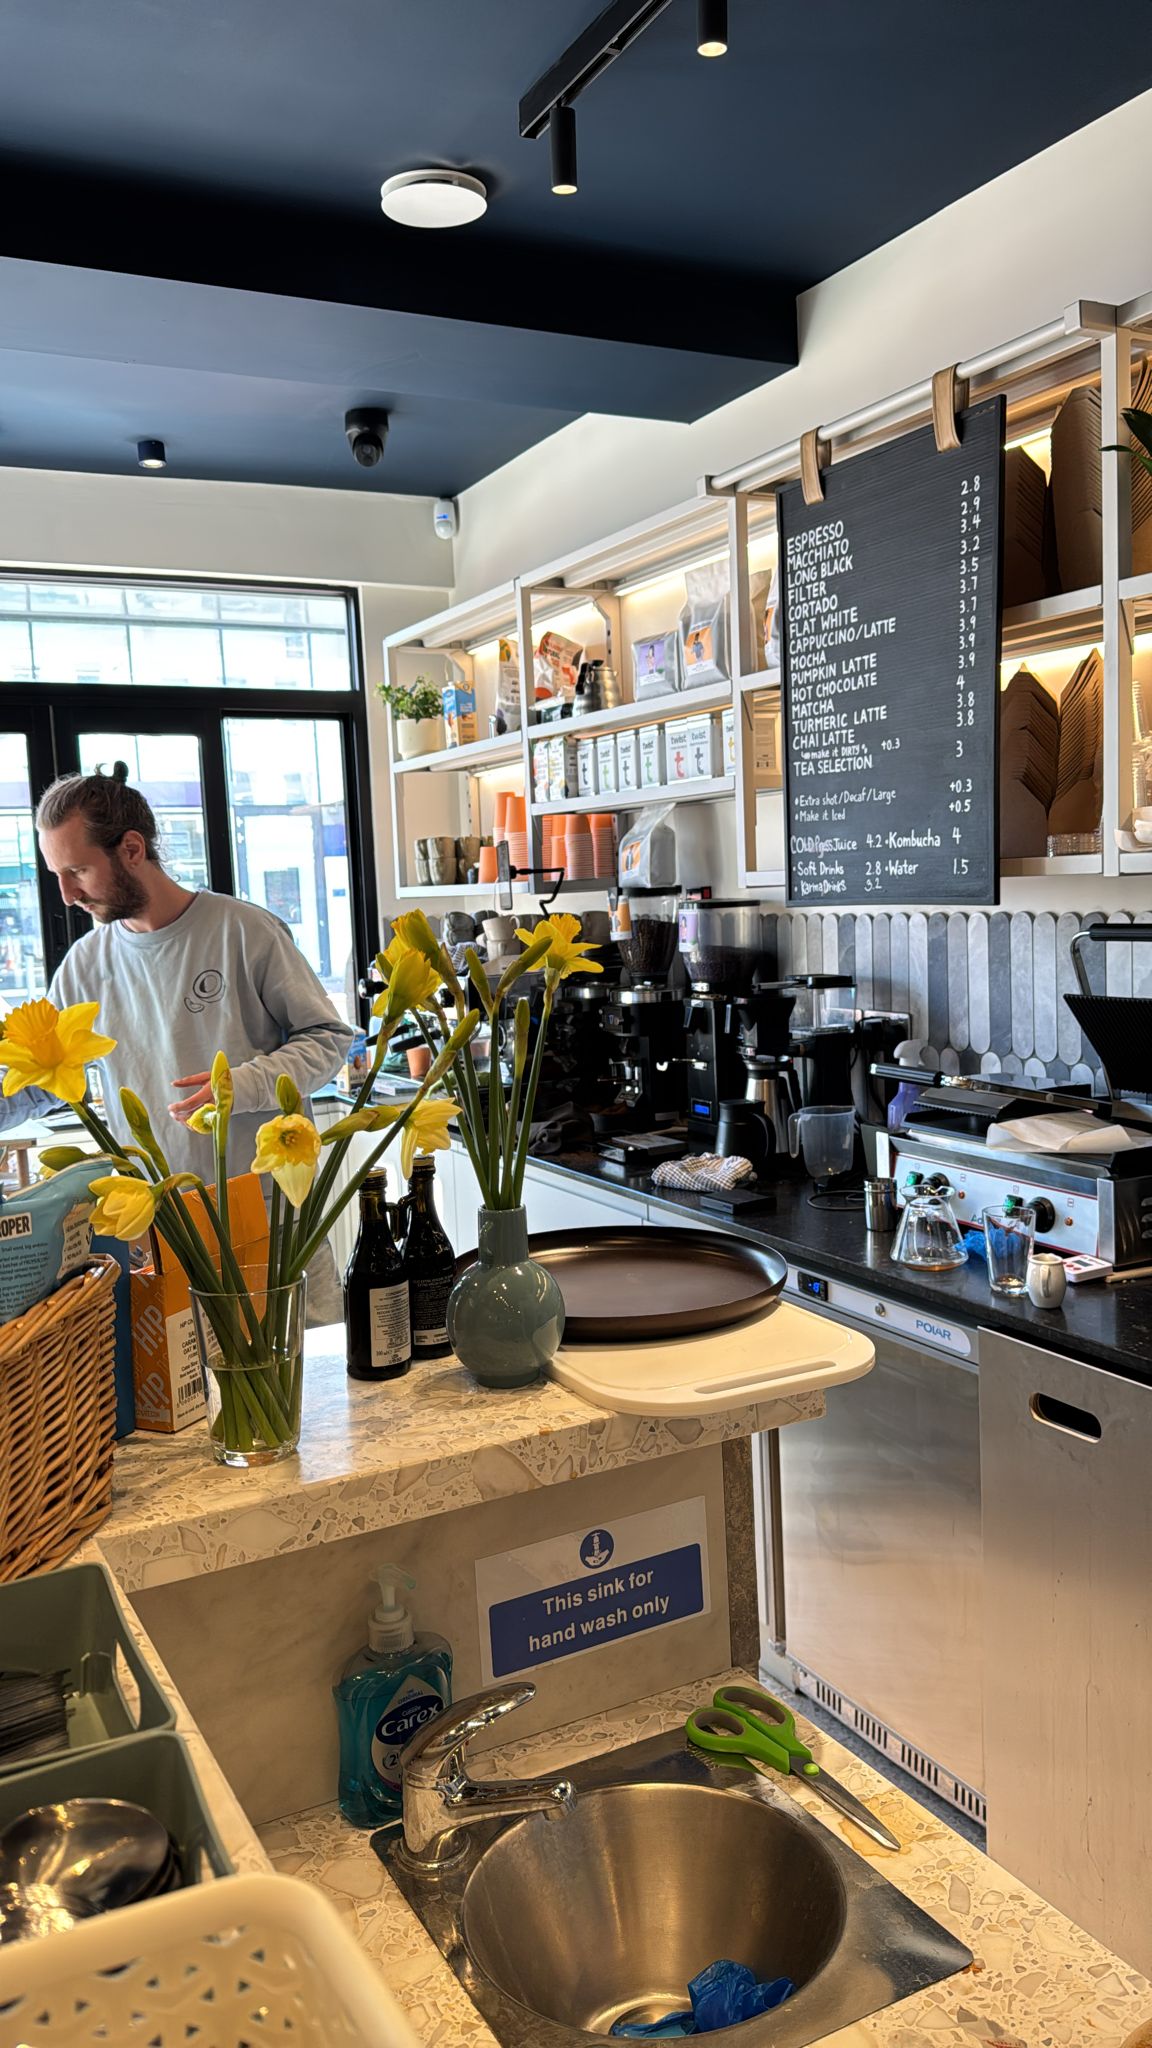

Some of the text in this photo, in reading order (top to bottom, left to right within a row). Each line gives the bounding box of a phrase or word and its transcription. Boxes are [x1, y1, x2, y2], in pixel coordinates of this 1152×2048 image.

[787, 475, 980, 555] ESPRESSO 2.8
[787, 496, 980, 572] MACCHIATO 2.9
[787, 514, 981, 588] LONG BLACK 3.4
[788, 536, 980, 606] FILTER 3.2
[788, 557, 979, 622] CORTADO 3.5
[789, 576, 978, 639] FLAT WHITE 3.7
[789, 596, 977, 655] CAPPUCCINO/LATTE 3.7
[790, 615, 977, 671] MOCHA 3.9
[791, 633, 976, 688] PUMPKIN LATTE 3.9
[791, 651, 976, 703] HOT CHOCOLATE 3.9
[791, 674, 966, 720] MATCHA 4
[792, 691, 975, 735] TURMERIC LATTE 3.8
[792, 709, 974, 751] CHAI LATTE 3.8
[811, 749, 830, 760] make
[832, 746, 839, 758] it
[841, 744, 861, 756] DIRTY
[793, 740, 964, 777] TEA SELECTION 3
[799, 794, 820, 807] Extra
[949, 778, 973, 794] +0.3
[799, 799, 972, 823] Make it Iced +0.5
[866, 833, 882, 848] 4.2
[888, 827, 941, 849] Kombucha
[952, 826, 962, 845] 4
[797, 857, 969, 876] Soft Drinks 2.8 Water 1.5
[864, 876, 882, 892] 3.2
[0, 1215, 30, 1238] OPER
[916, 1319, 952, 1341] POLAR
[543, 1570, 654, 1615] This sink for
[528, 1595, 670, 1652] hand wash only
[381, 1702, 440, 1737] Carex
